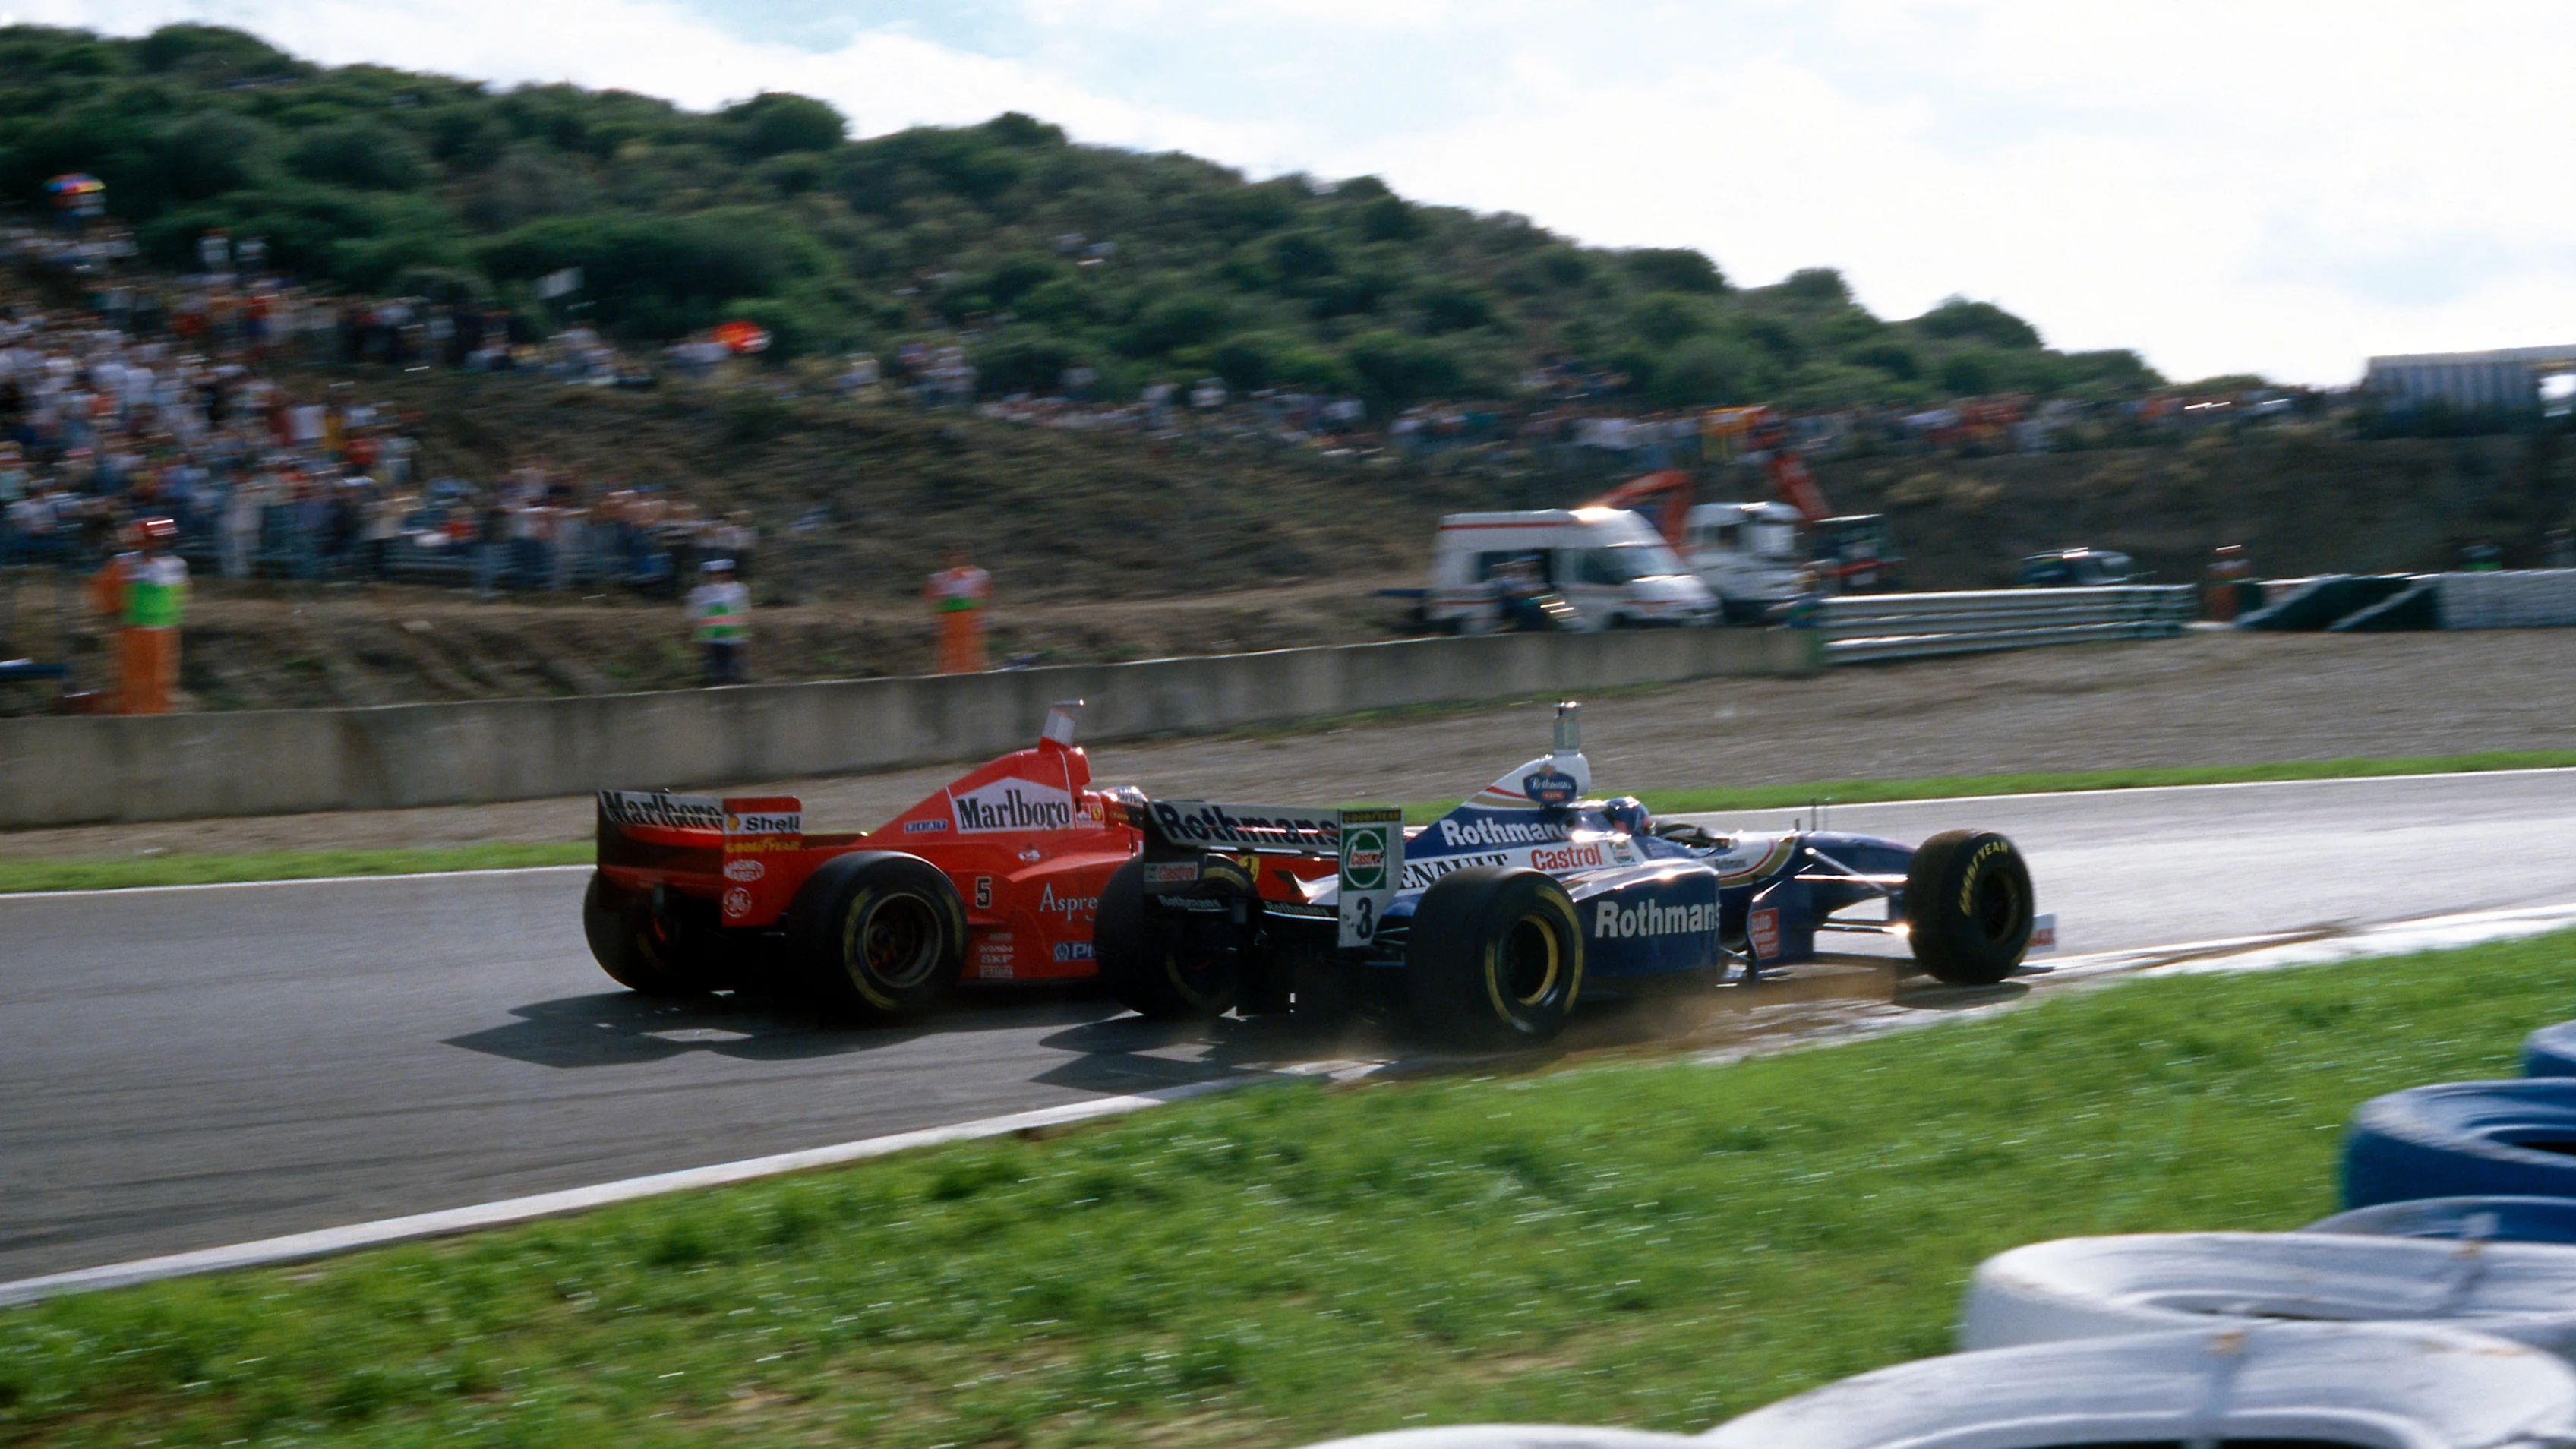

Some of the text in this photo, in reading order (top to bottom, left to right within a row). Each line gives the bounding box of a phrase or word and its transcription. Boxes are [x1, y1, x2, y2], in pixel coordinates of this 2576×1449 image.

[1530, 777, 1571, 790] Rothmans
[957, 790, 1070, 829] Marlboro
[746, 816, 800, 833] Shell
[1154, 803, 1339, 846] Rothmans
[1439, 817, 1574, 847] Rothmans
[1400, 854, 1507, 890] ENAT
[1530, 843, 1603, 872] Castrol
[1157, 864, 1198, 881] Castrol
[975, 876, 992, 908] 5
[1157, 895, 1222, 909] Rothmans
[1264, 900, 1331, 917] Rothmans
[1356, 897, 1373, 939] 3
